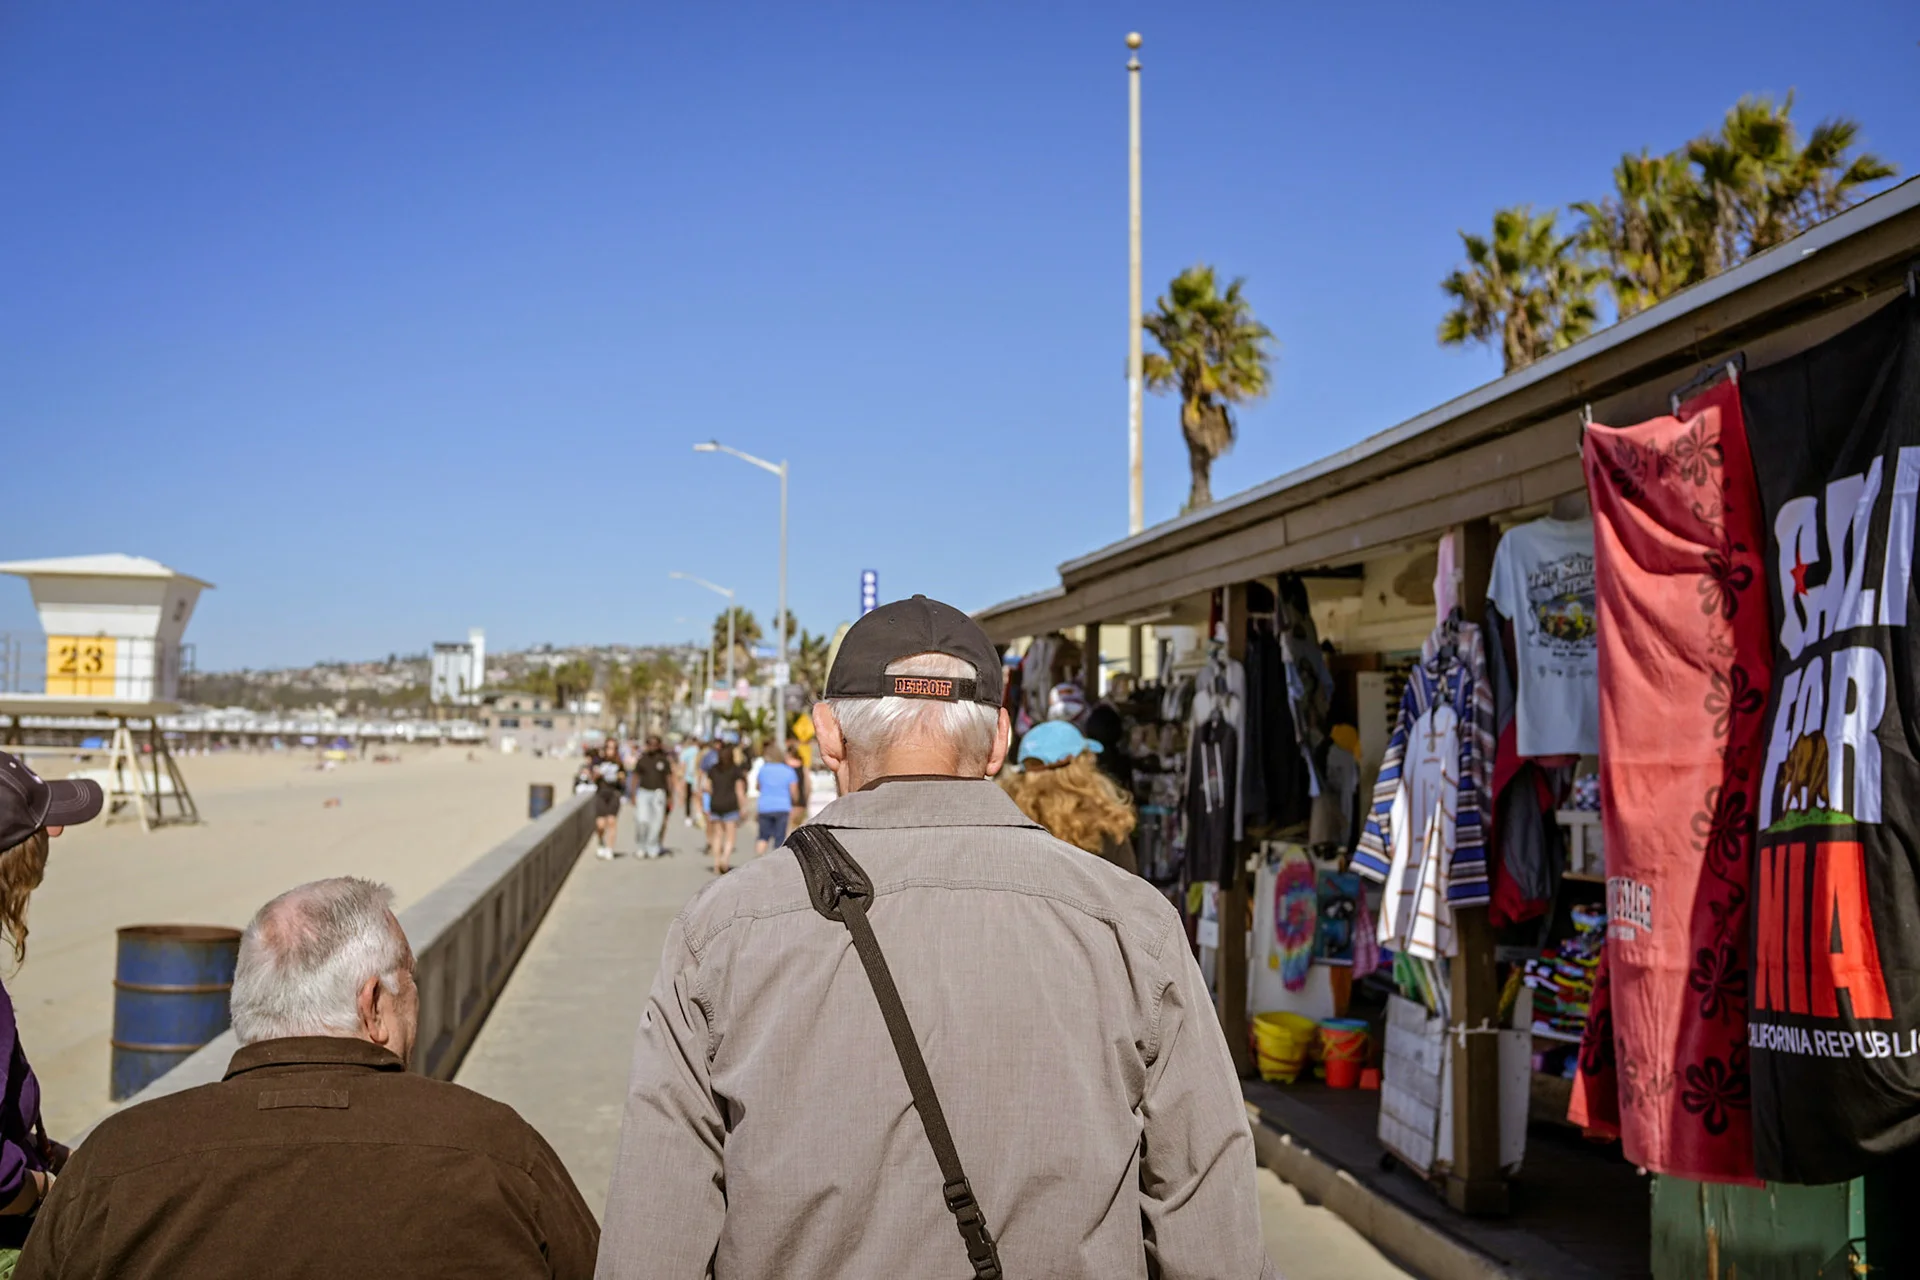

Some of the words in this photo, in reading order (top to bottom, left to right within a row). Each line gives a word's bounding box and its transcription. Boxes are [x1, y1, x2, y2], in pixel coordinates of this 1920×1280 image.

[59, 646, 104, 673] 23
[895, 678, 952, 696] DETROIT
[1755, 841, 1892, 1019] NIA
[1813, 1028, 1920, 1059] REPUBLI
